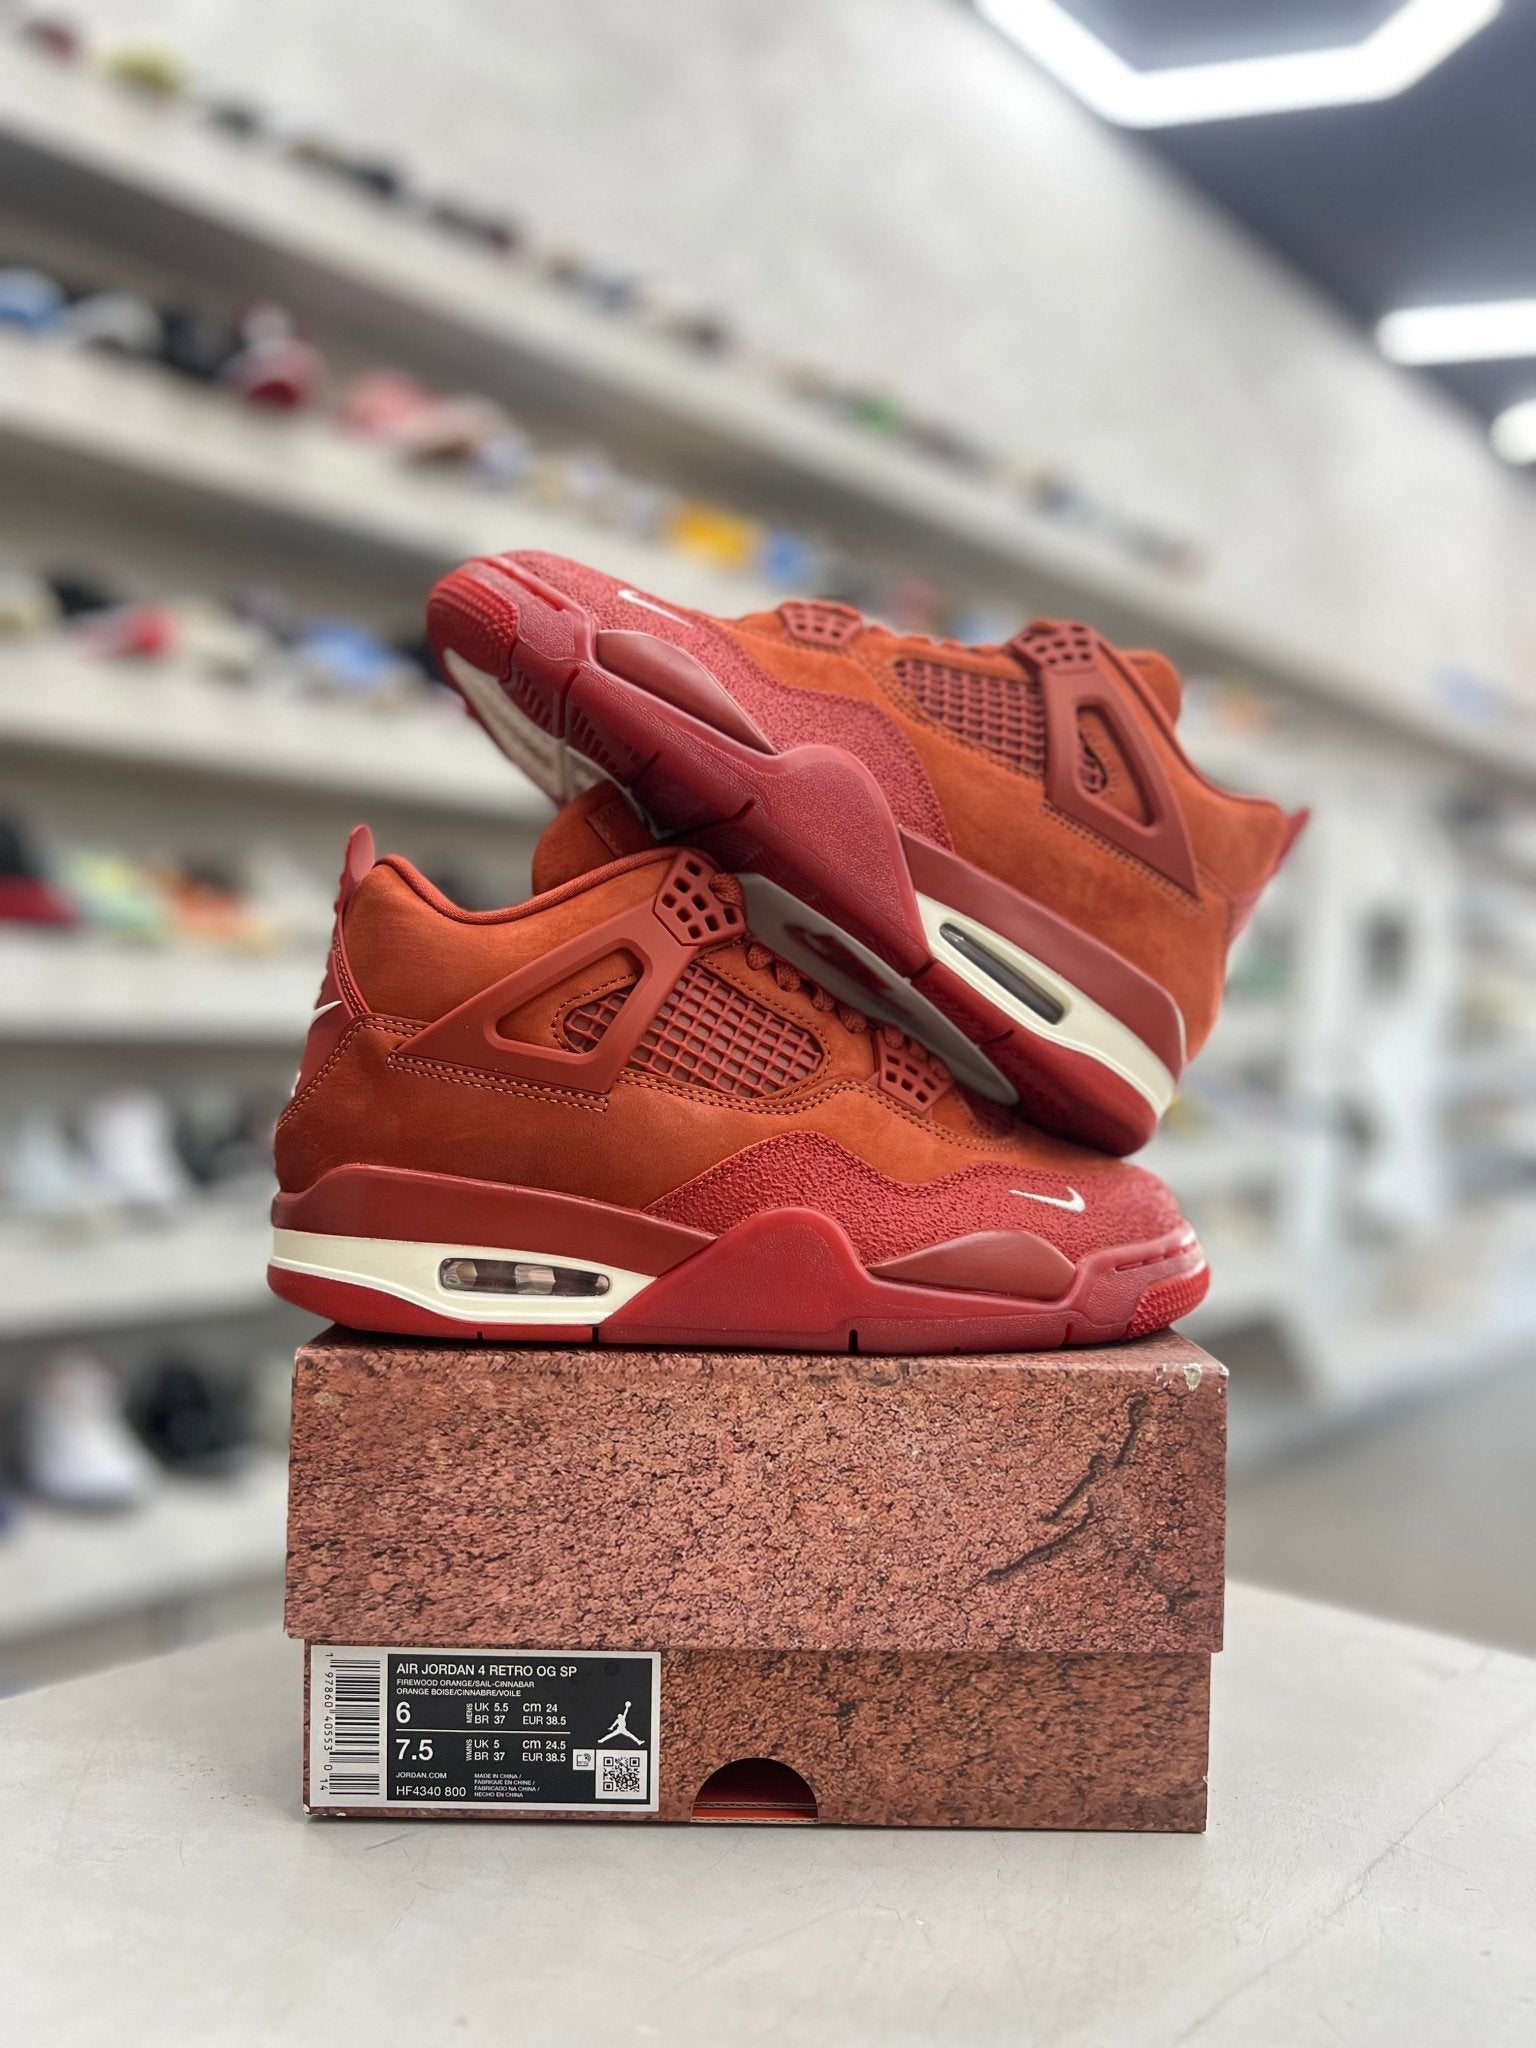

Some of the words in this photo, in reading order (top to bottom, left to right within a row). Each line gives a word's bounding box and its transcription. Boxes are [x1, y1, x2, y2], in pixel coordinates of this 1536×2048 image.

[396, 1663, 418, 1675] AIR
[421, 1663, 475, 1676] JORDAN
[478, 1664, 486, 1676] 4
[489, 1665, 534, 1677] RETRO
[536, 1665, 557, 1677] OG
[560, 1666, 577, 1677] SP
[396, 1679, 438, 1687] FIREWOOD
[440, 1679, 535, 1688] ORANGE/SAIL-CINNABAR
[324, 1672, 334, 1708] 97860
[396, 1687, 429, 1695] ORANGE
[431, 1688, 522, 1697] BOISE/CINNABRE/VOILE
[474, 1702, 489, 1712] UK
[493, 1702, 509, 1712] 5.5
[522, 1703, 542, 1712] cm
[546, 1703, 559, 1713] 24
[396, 1701, 411, 1724] 6
[474, 1715, 489, 1724] BR
[493, 1715, 506, 1724] 37
[522, 1715, 544, 1725] EUR
[546, 1716, 567, 1726] 38.5
[324, 1716, 333, 1751] 40553
[474, 1739, 489, 1749] UK
[493, 1739, 500, 1749] 5
[522, 1740, 542, 1749] cm
[545, 1740, 567, 1750] 24.5
[396, 1738, 434, 1761] 7.5
[474, 1752, 489, 1761] BR
[493, 1752, 506, 1761] 37
[522, 1752, 543, 1762] EUR
[545, 1753, 567, 1762] 38.5
[396, 1771, 447, 1779] JORDAN.COM
[320, 1778, 328, 1791] 14
[396, 1785, 441, 1796] HF4340
[444, 1786, 467, 1797] 800
